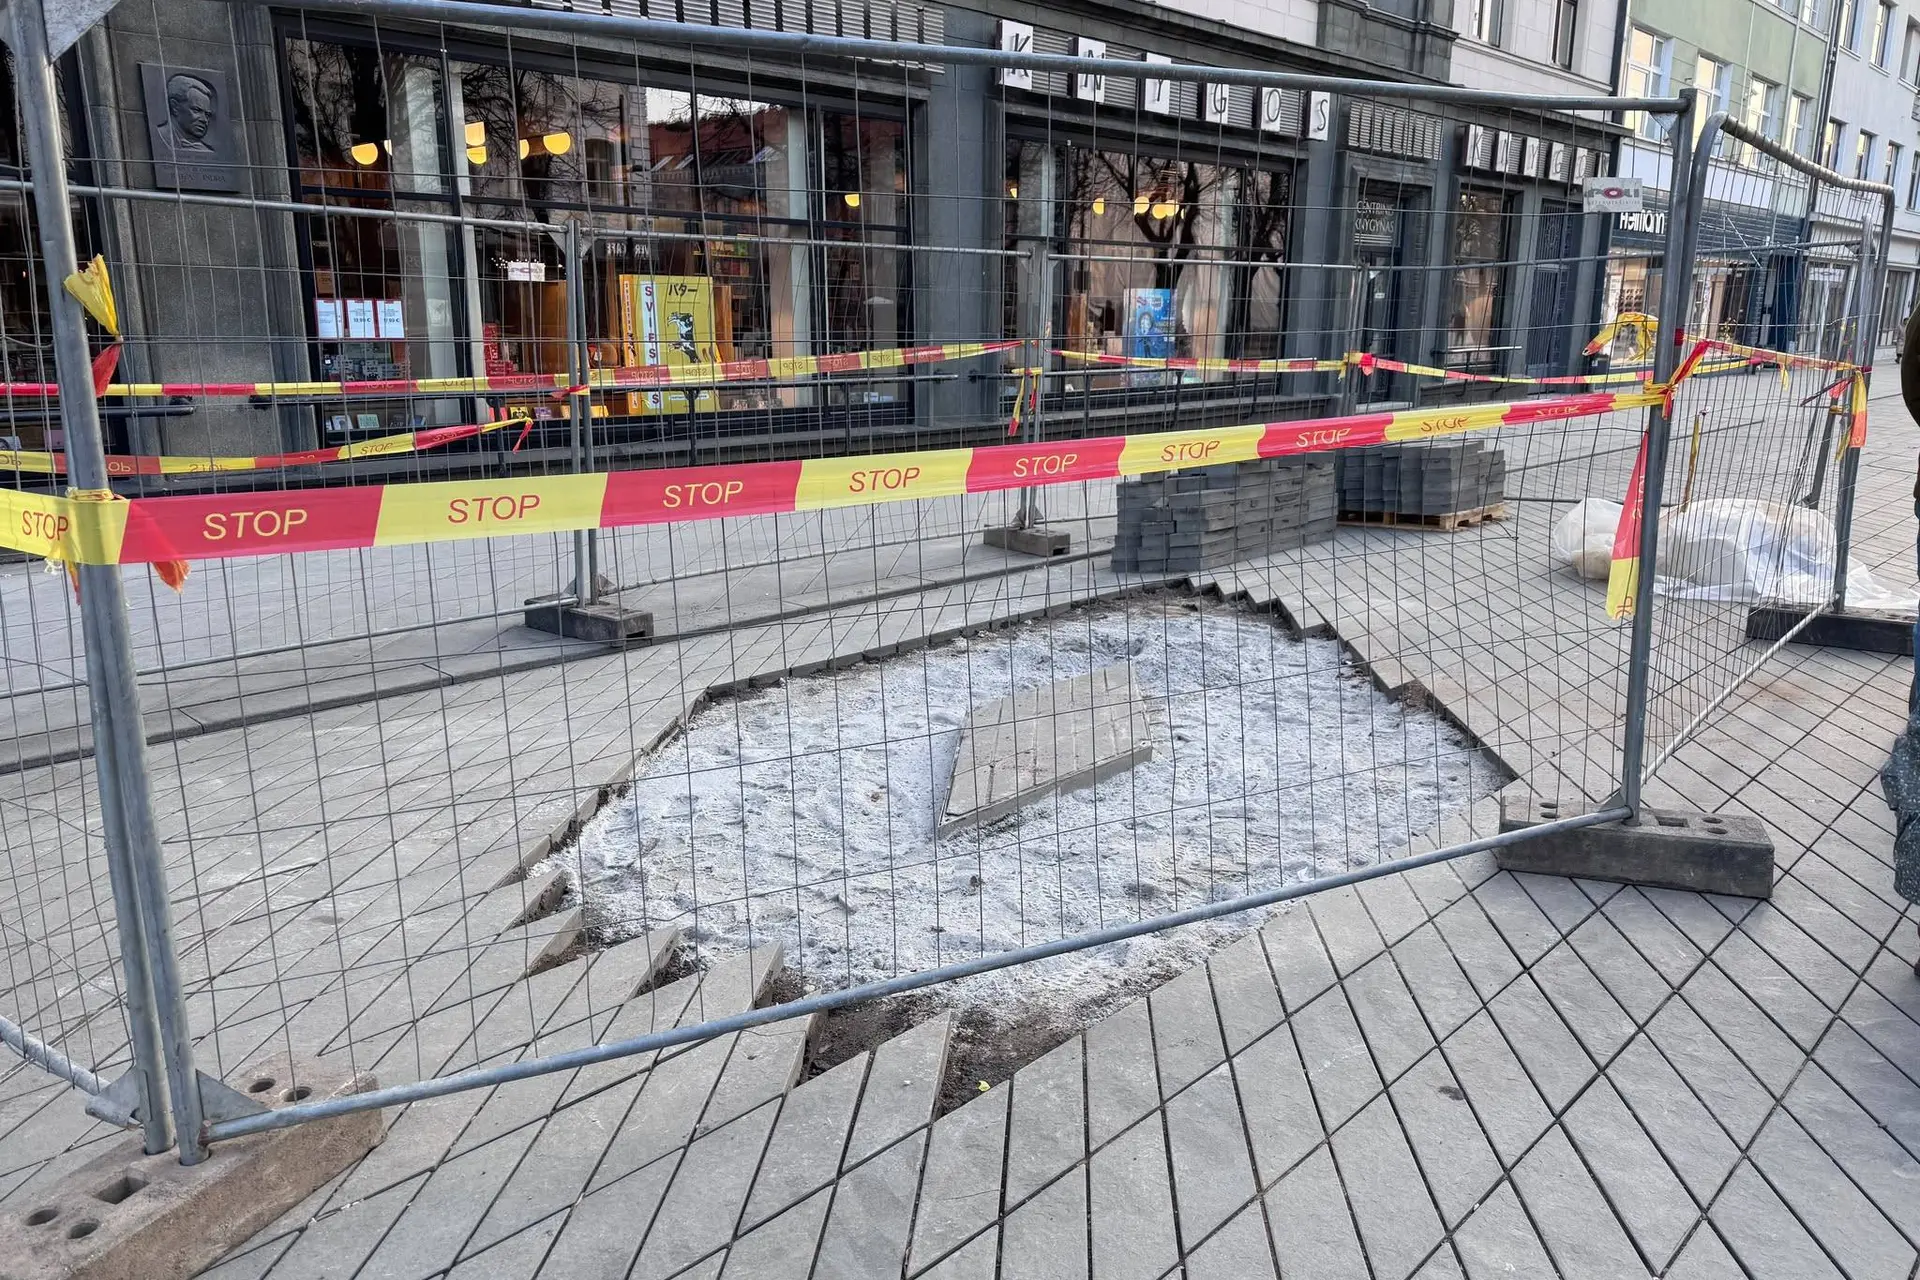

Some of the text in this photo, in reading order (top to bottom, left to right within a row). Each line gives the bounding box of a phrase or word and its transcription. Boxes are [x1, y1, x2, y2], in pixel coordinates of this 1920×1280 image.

[1010, 32, 1329, 131] KNYGOS
[644, 285, 661, 404] SVIESS
[22, 510, 69, 541] STOP
[202, 508, 308, 541] STOP
[447, 493, 540, 524] STOP
[662, 480, 744, 508] STOP
[848, 467, 920, 493] STOP
[1013, 453, 1078, 477] STOP
[1160, 440, 1221, 462] STOP
[1295, 427, 1351, 448] STOP
